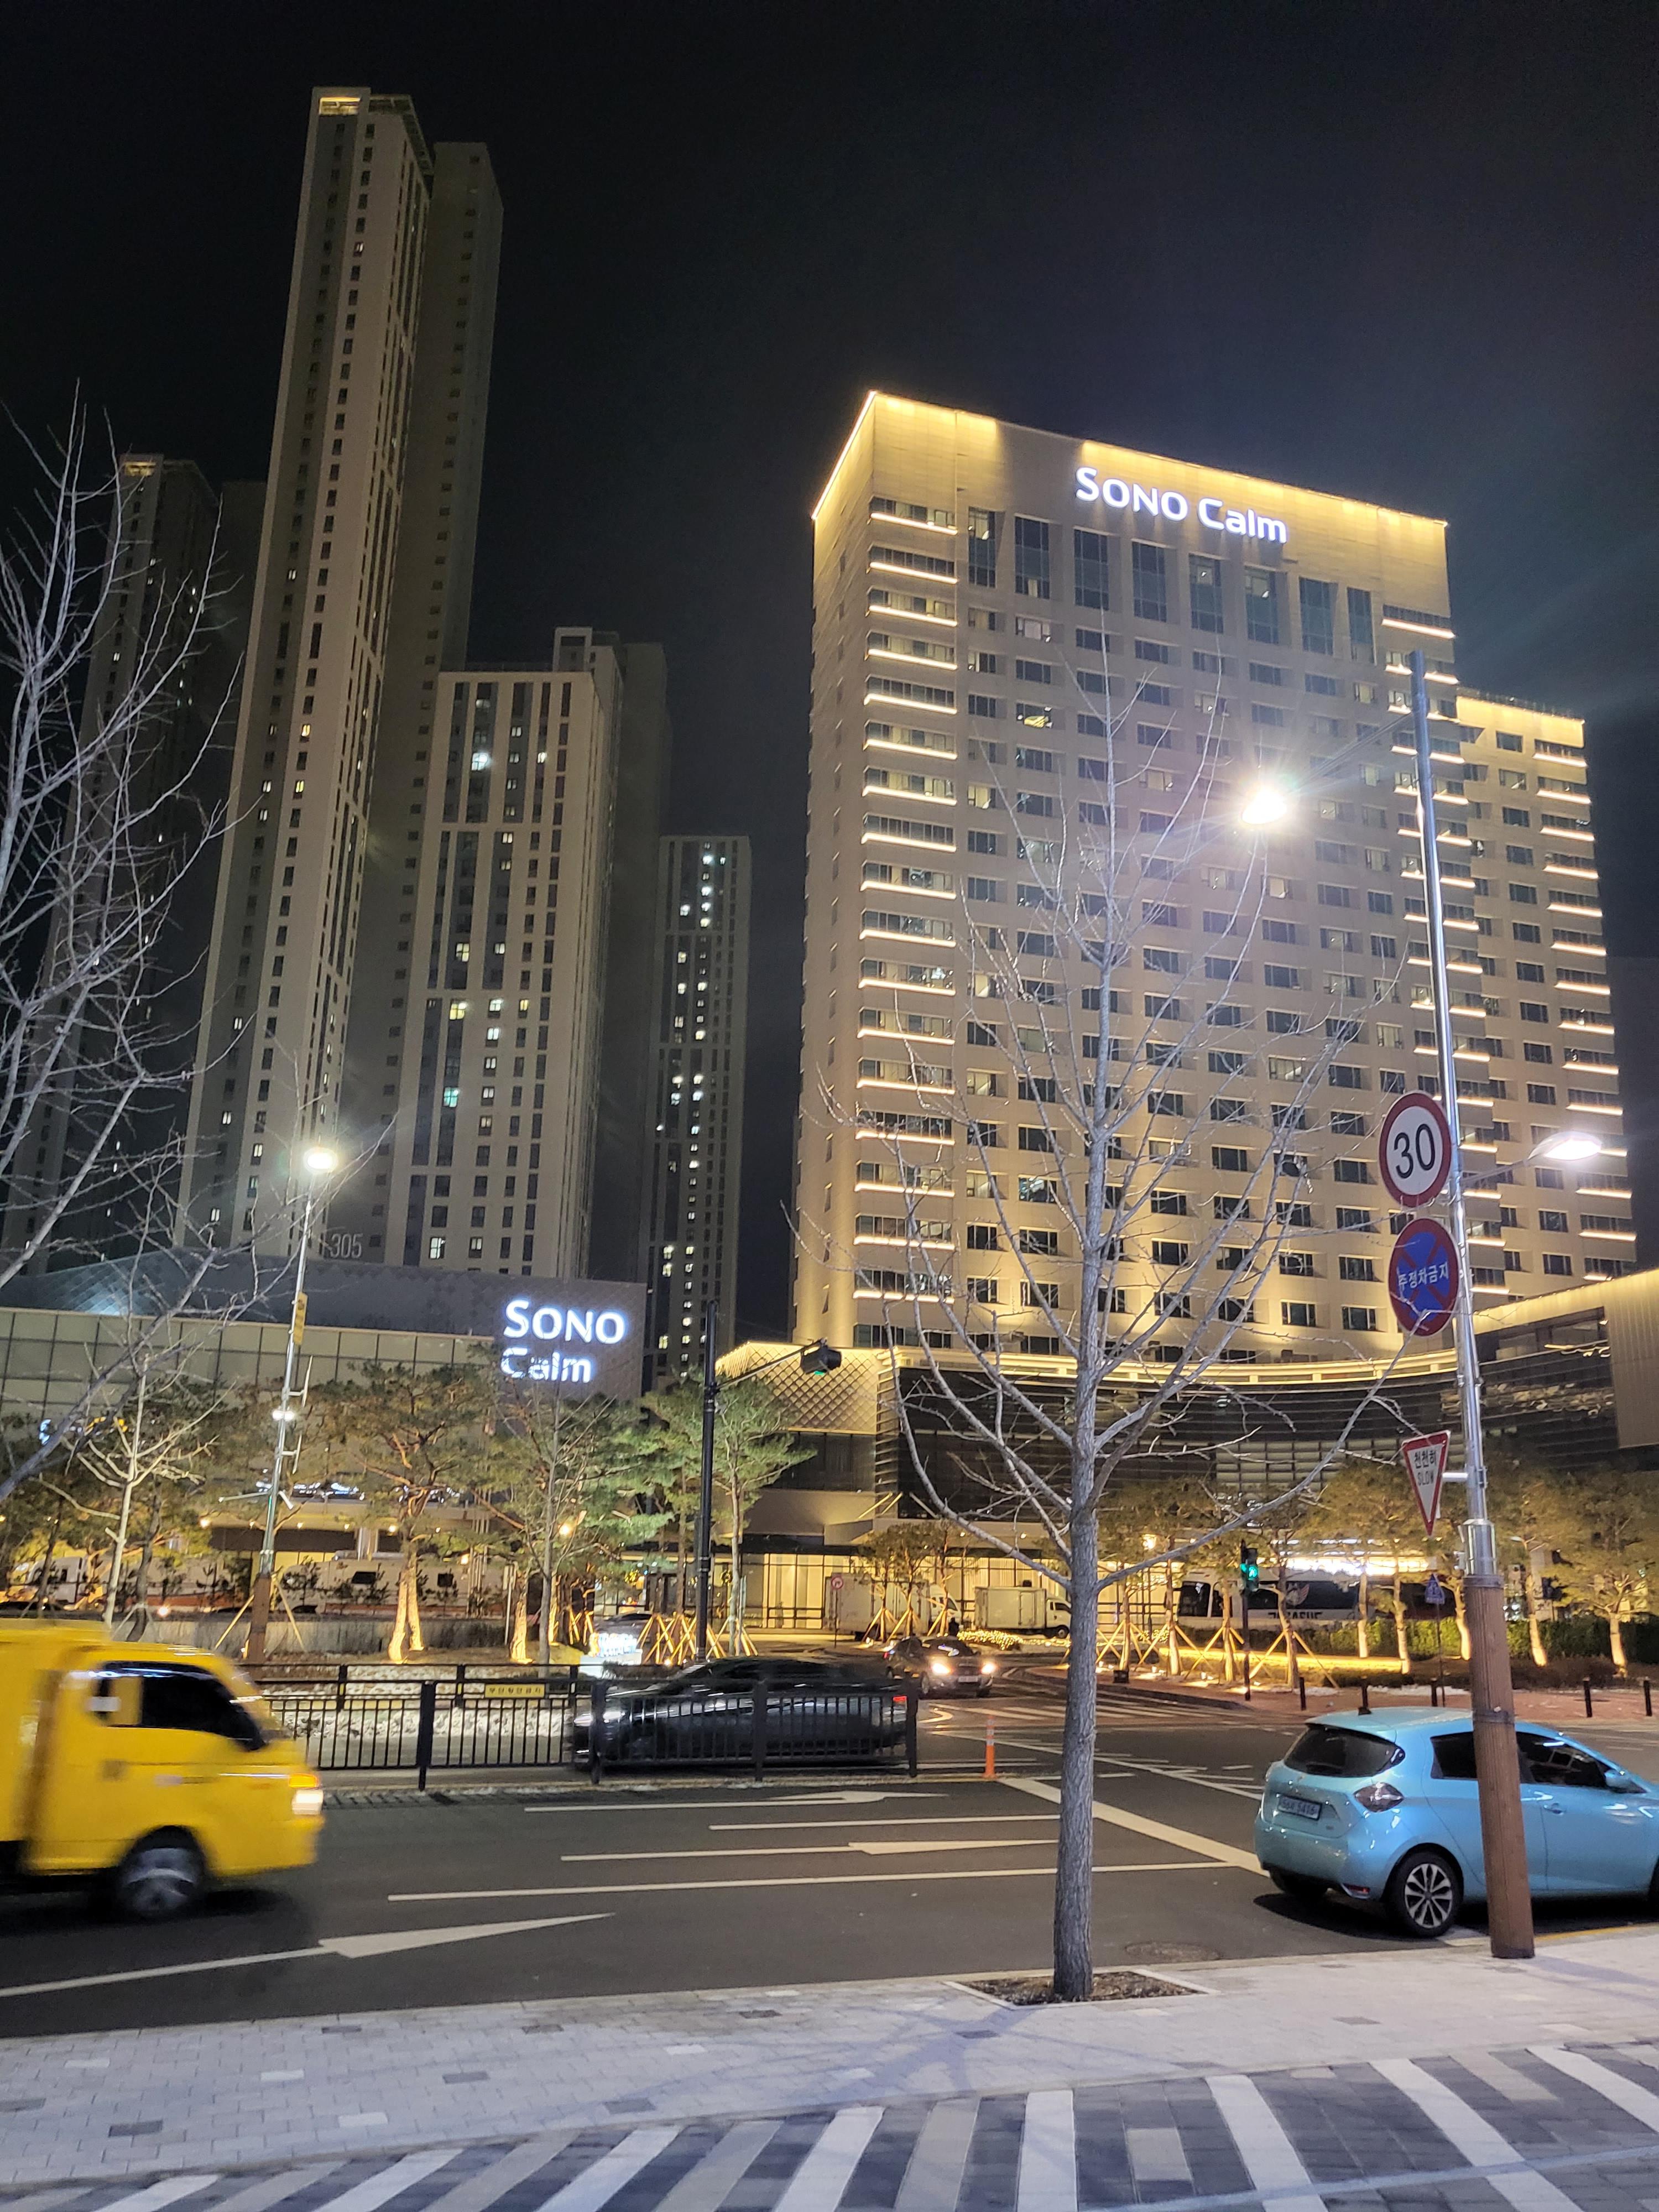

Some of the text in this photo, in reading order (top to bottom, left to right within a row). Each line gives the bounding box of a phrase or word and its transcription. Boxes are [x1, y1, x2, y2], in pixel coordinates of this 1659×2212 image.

[1075, 466, 1288, 544] SONO Calm
[1394, 1123, 1436, 1180] 30
[330, 1233, 363, 1259] 305
[1398, 1262, 1449, 1291] 주정차금지
[503, 1300, 626, 1344] SONO
[500, 1347, 592, 1383] Calm
[1414, 1449, 1437, 1469] 천천히
[1417, 1470, 1434, 1486] SLOW
